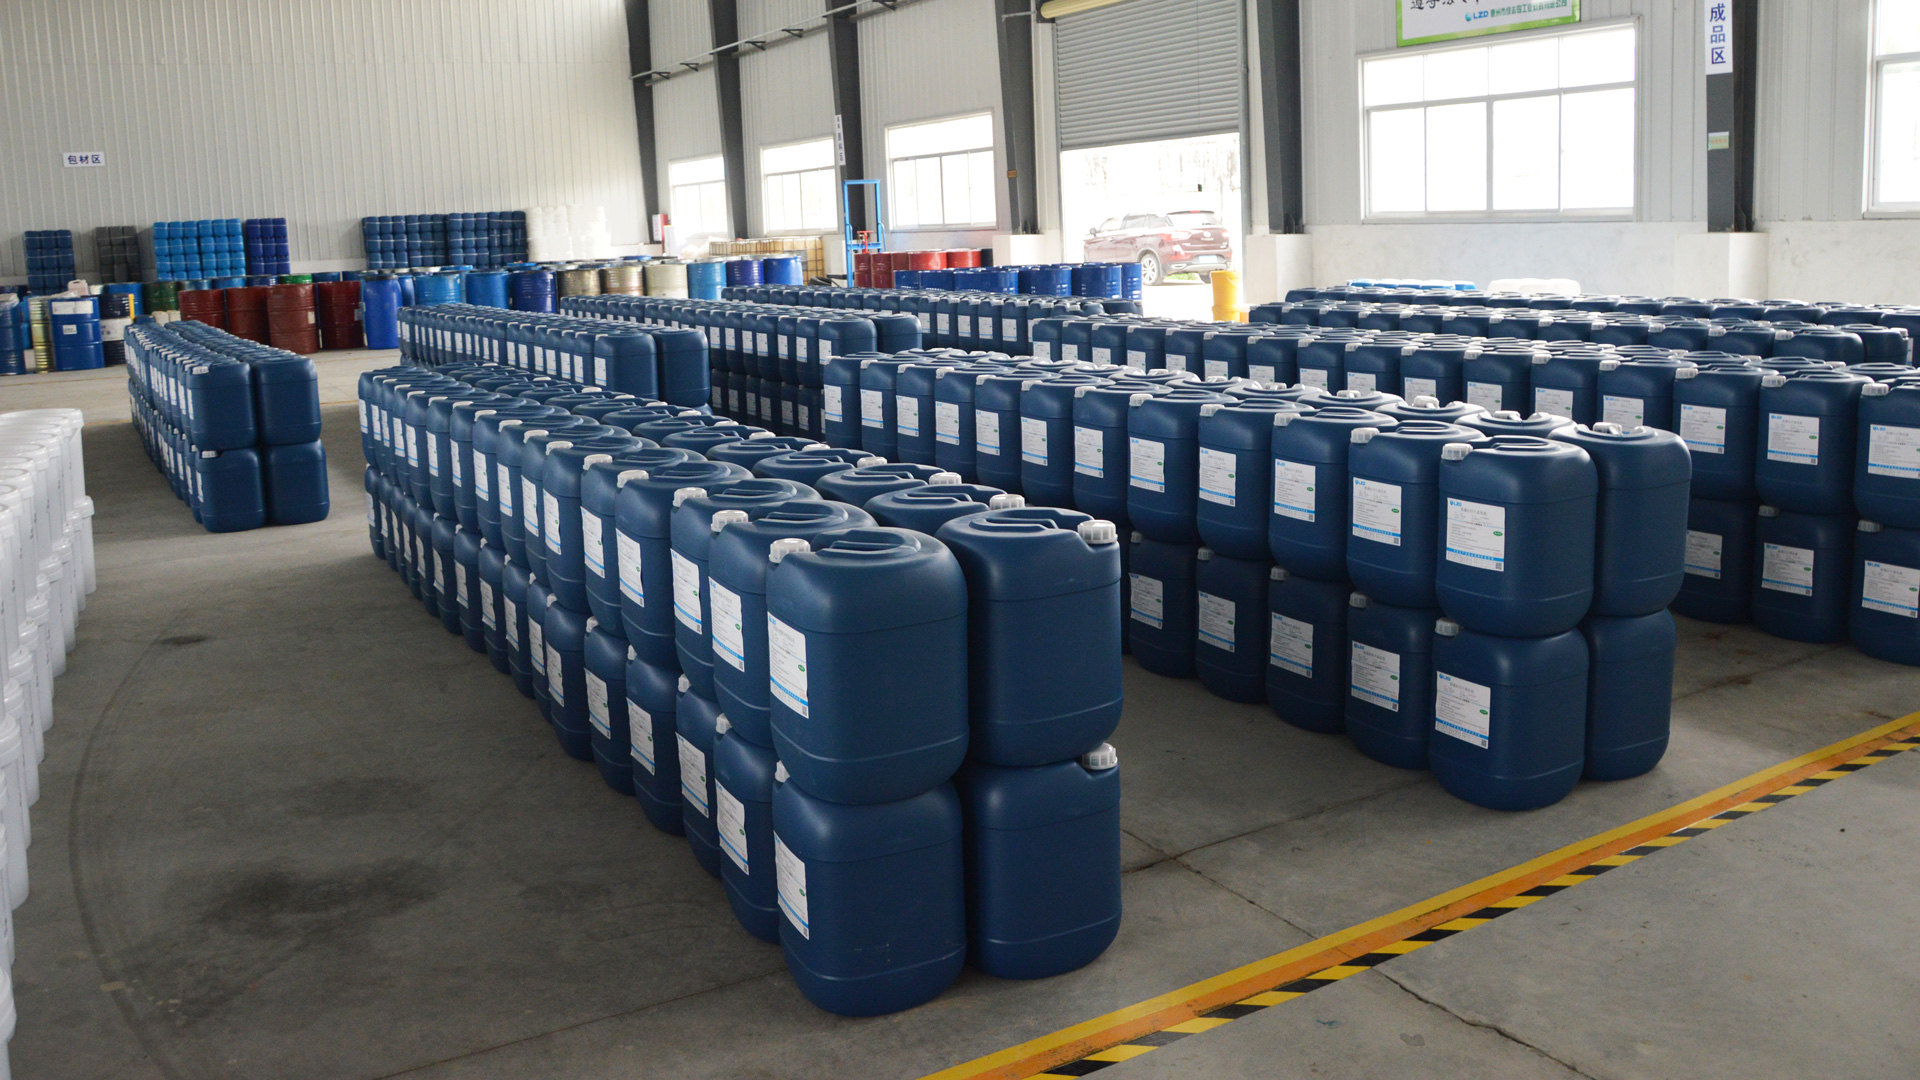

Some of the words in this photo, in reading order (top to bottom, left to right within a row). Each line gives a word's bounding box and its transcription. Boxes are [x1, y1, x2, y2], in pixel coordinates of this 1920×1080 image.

[1473, 10, 1489, 20] LZD
[1709, 3, 1726, 64] 成品区
[67, 154, 102, 165] 包材区
